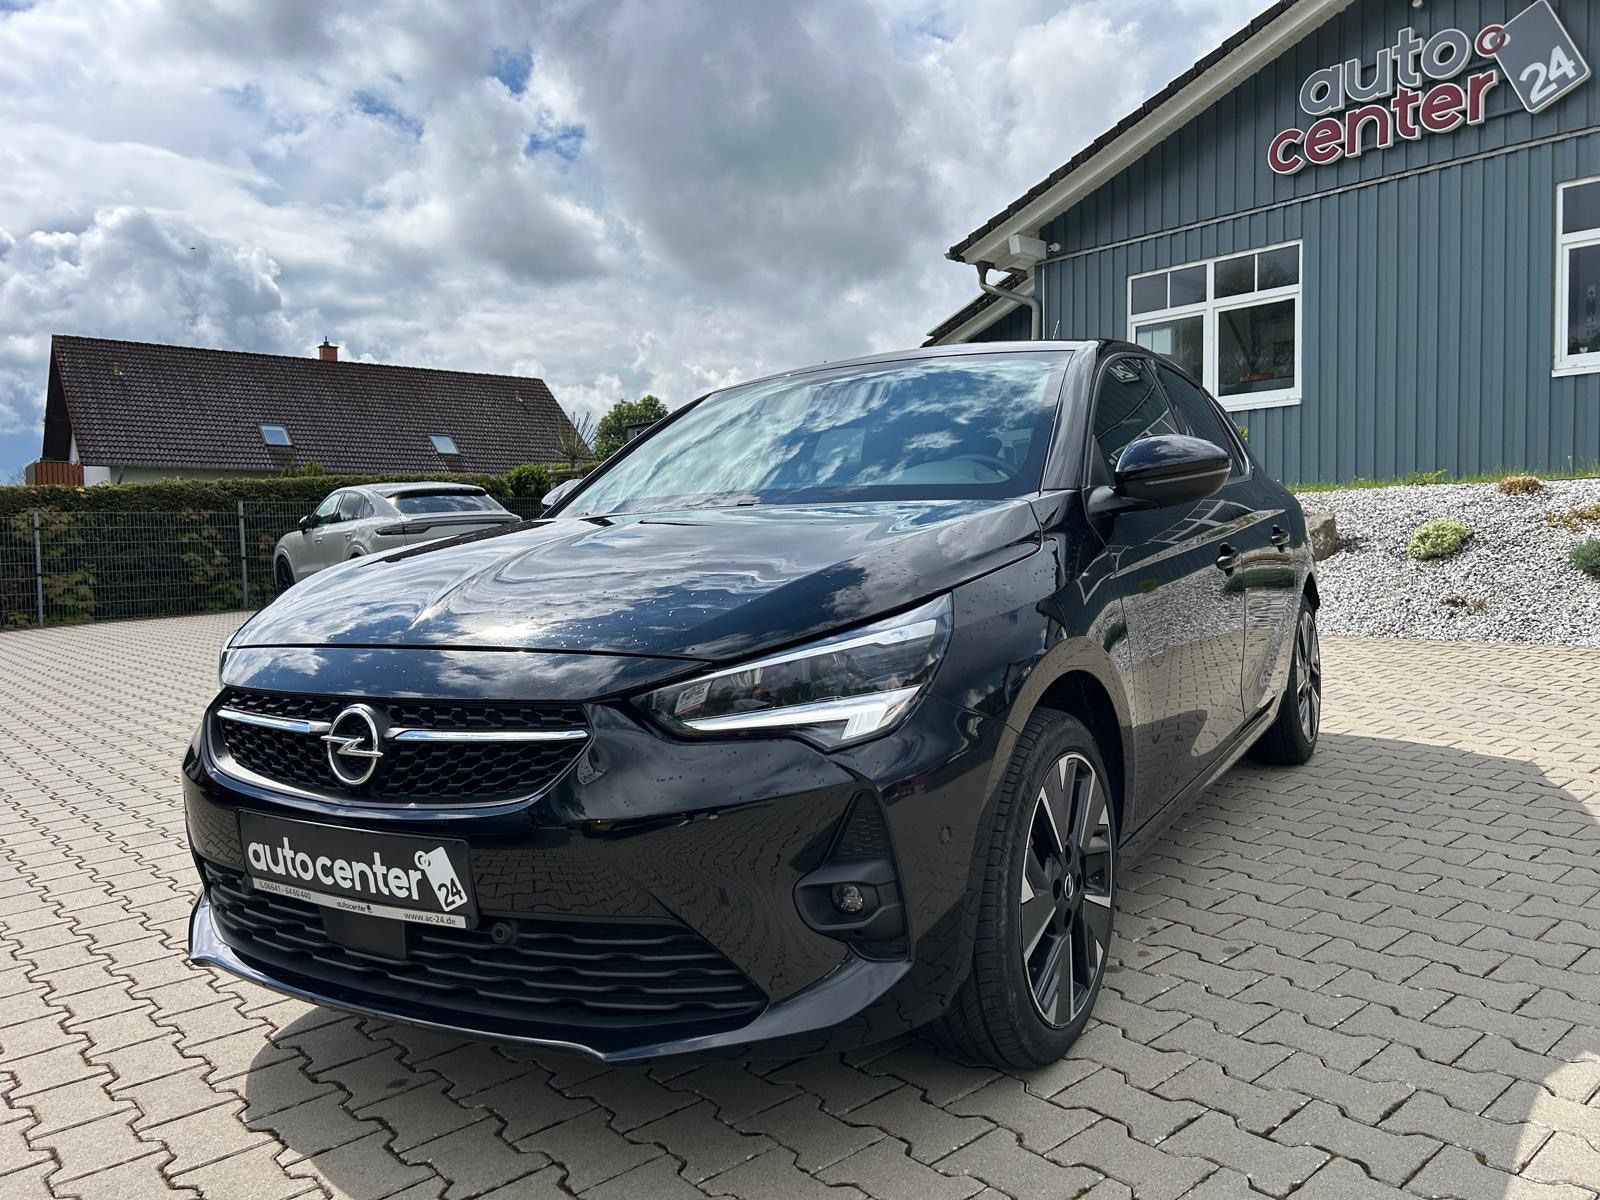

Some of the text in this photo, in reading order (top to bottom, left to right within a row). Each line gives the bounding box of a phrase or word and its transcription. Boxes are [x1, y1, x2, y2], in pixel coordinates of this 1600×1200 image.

[1299, 26, 1472, 116] auto
[1519, 45, 1578, 104] 24
[1267, 69, 1499, 175] center
[336, 901, 367, 912] autocenter
[437, 878, 464, 908] 24
[404, 911, 457, 926] www.ac-24.de
